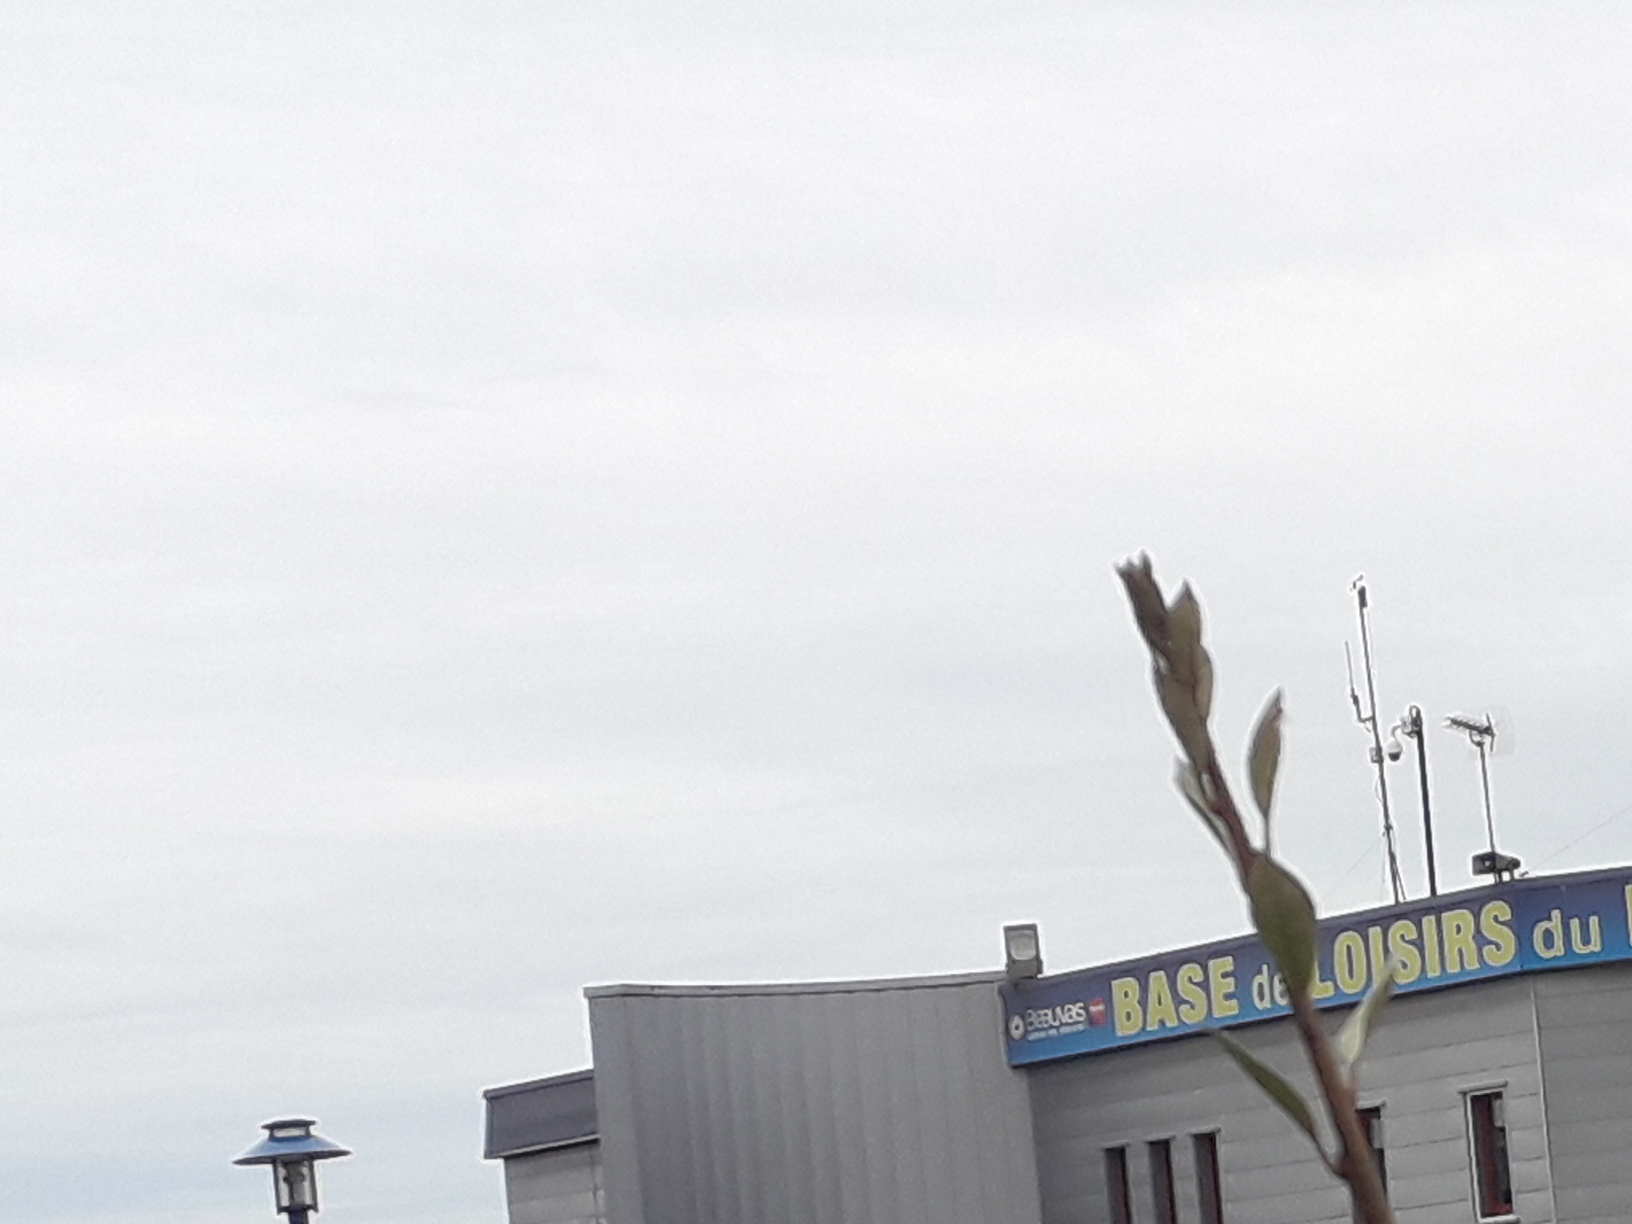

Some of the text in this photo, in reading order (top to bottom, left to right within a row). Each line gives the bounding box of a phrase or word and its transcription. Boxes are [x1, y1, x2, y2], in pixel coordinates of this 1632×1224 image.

[1111, 955, 1240, 1038] BASE
[1252, 963, 1290, 1011] de
[1531, 907, 1603, 959] du
